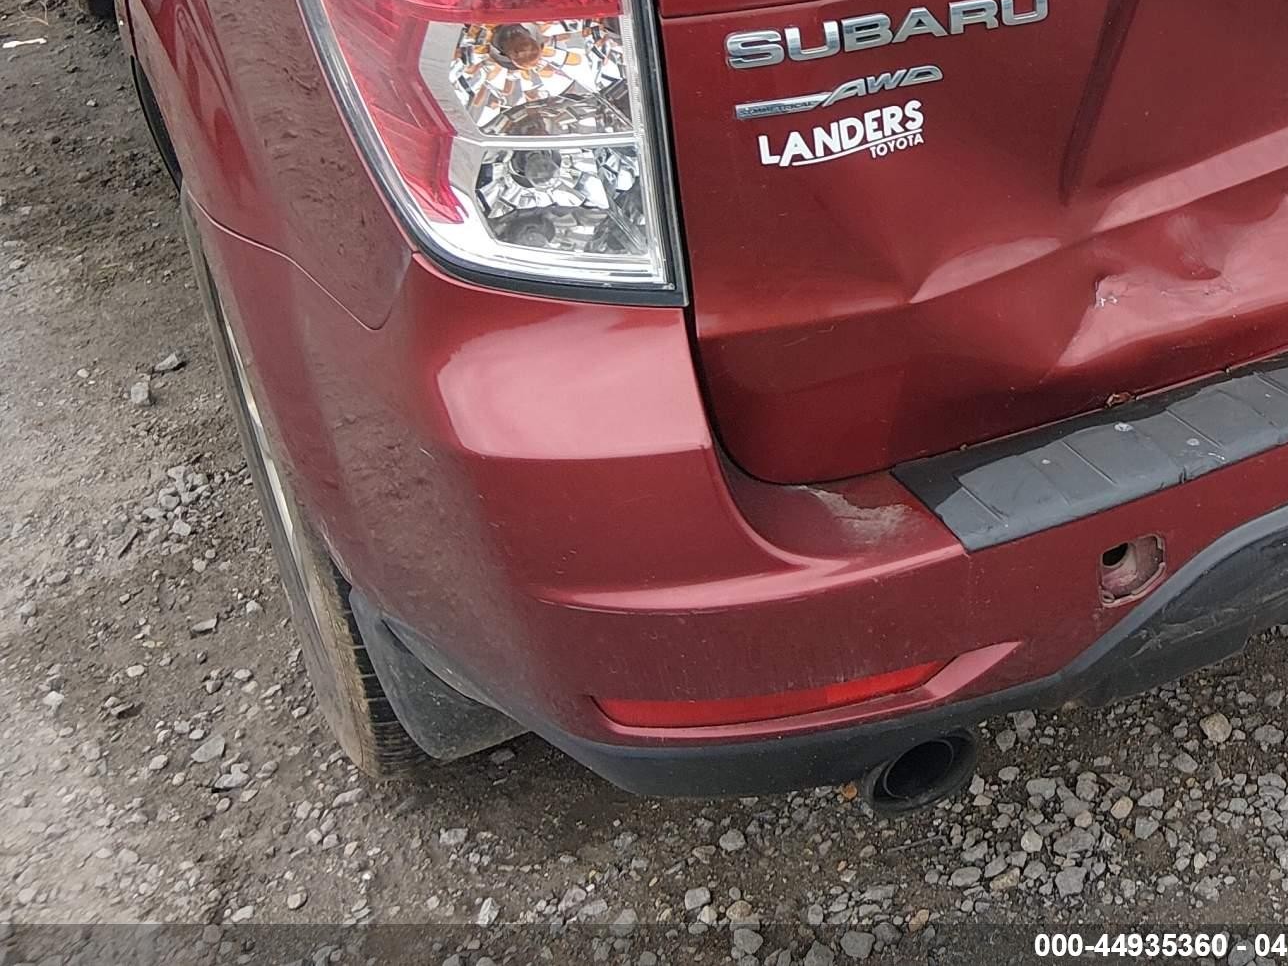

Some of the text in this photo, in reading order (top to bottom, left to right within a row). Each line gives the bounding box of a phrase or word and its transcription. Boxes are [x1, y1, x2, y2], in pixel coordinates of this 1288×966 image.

[821, 65, 943, 107] AWD
[758, 101, 924, 165] LANDERS
[870, 134, 924, 159] TOYOTA
